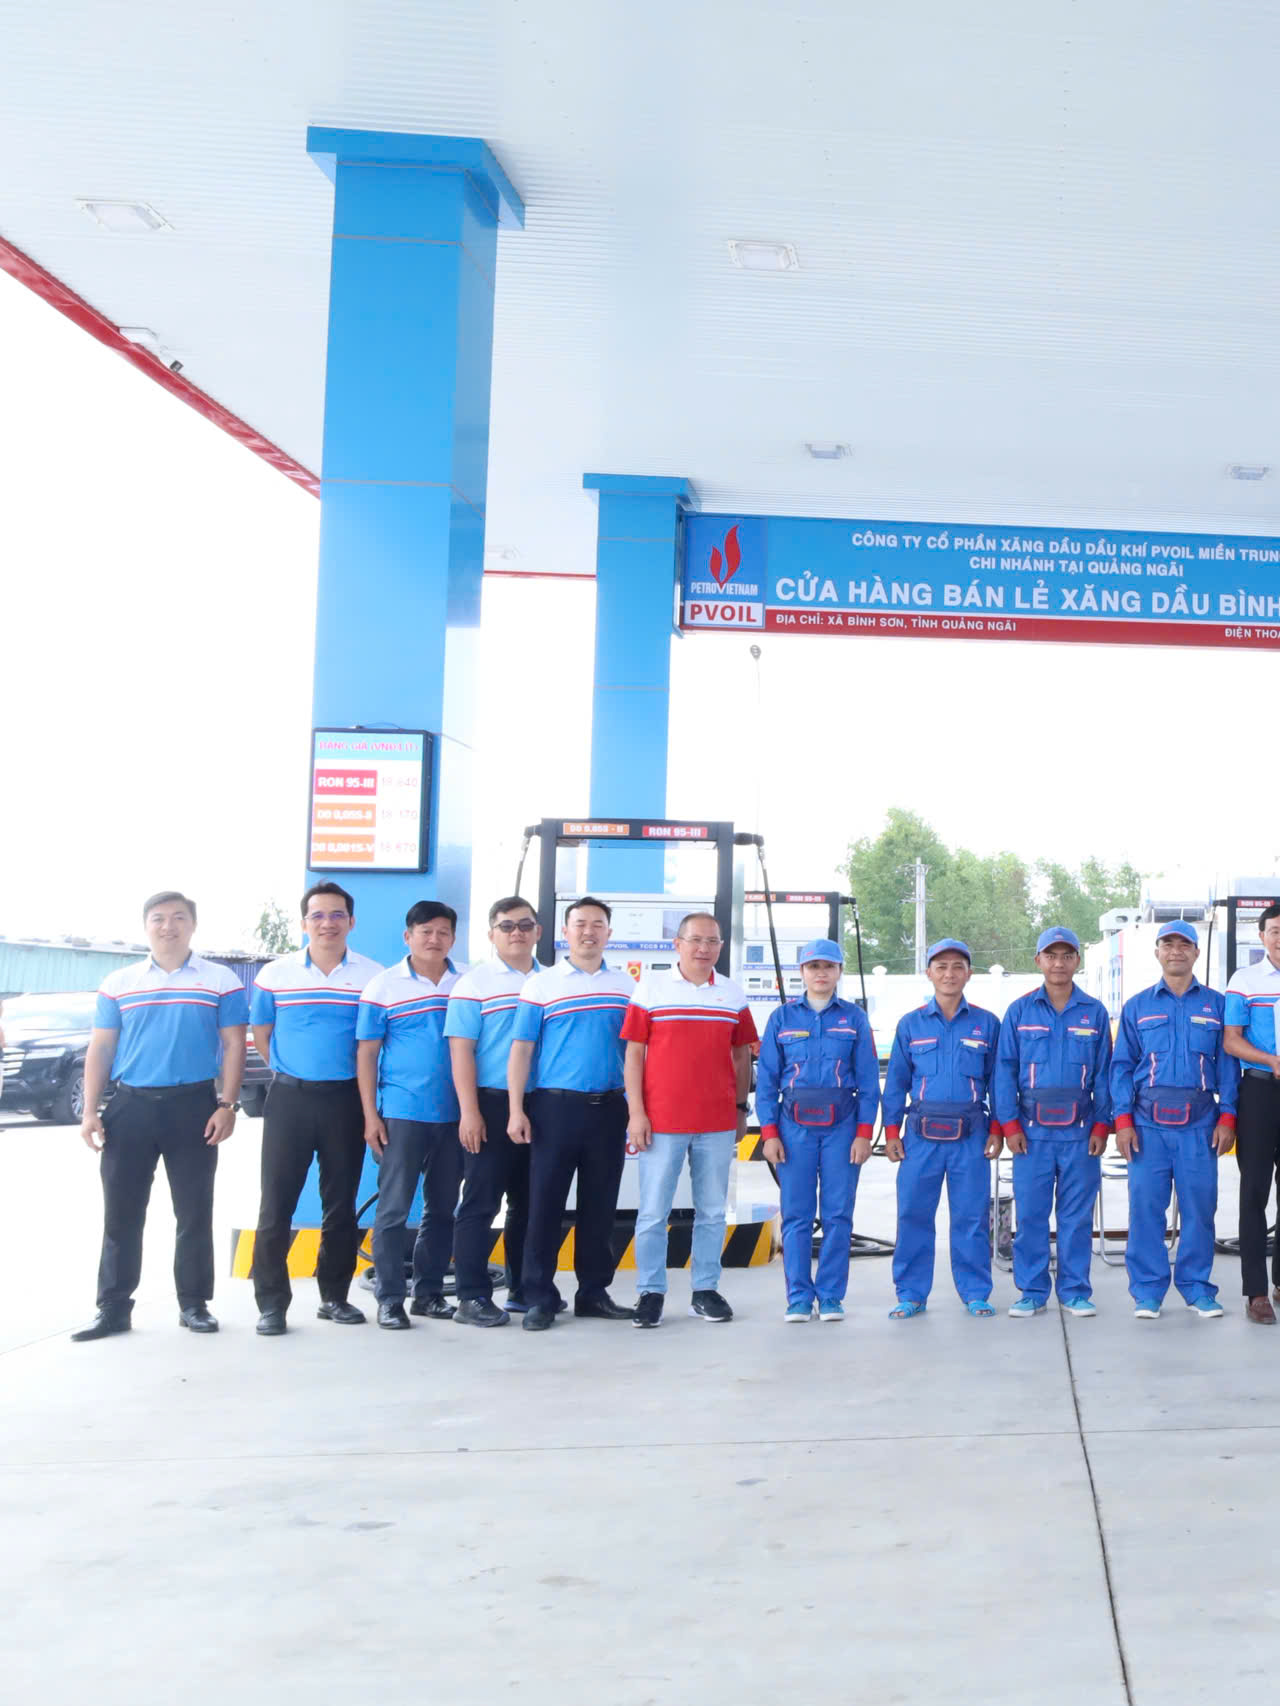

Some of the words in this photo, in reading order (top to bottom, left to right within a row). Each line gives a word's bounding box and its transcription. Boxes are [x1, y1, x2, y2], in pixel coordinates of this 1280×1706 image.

[852, 530, 898, 548] CÔNG
[902, 535, 922, 548] TY
[926, 530, 949, 549] CỔ
[954, 532, 997, 551] PHẦN
[1001, 536, 1045, 553] XĂNG
[1049, 536, 1081, 554] DẦU
[1085, 538, 1117, 556] DẦU
[1121, 541, 1148, 557] KHÍ
[1151, 545, 1195, 559] PVOIL
[1198, 542, 1235, 560] MIỀN
[969, 556, 996, 569] CHI
[1000, 555, 1054, 572] NHÁNH
[1059, 560, 1083, 575] TẠI
[1087, 557, 1142, 576] QUẢNG
[1146, 561, 1184, 577] NGÃI
[690, 582, 759, 596] PETROVIETNAM
[775, 570, 839, 602] CỬA
[848, 575, 932, 606] HÀNG
[943, 579, 1004, 608] BÁN
[1015, 579, 1049, 609] LẺ
[1060, 584, 1141, 613] XĂNG
[1151, 584, 1209, 615] DẦU
[690, 603, 758, 622] PVOIL
[775, 614, 796, 626] ĐỊA
[800, 612, 824, 625] CHỈ:
[827, 613, 844, 626] XÃ
[847, 615, 876, 627] BÌNH
[879, 617, 908, 629] SƠN,
[911, 616, 938, 628] TỈNH
[941, 616, 984, 630] QUẢNG
[987, 619, 1017, 631] NGÃI
[1224, 626, 1252, 640] ĐIỆN
[318, 776, 344, 788] RON
[649, 826, 671, 836] RON
[673, 827, 702, 837] 95-III
